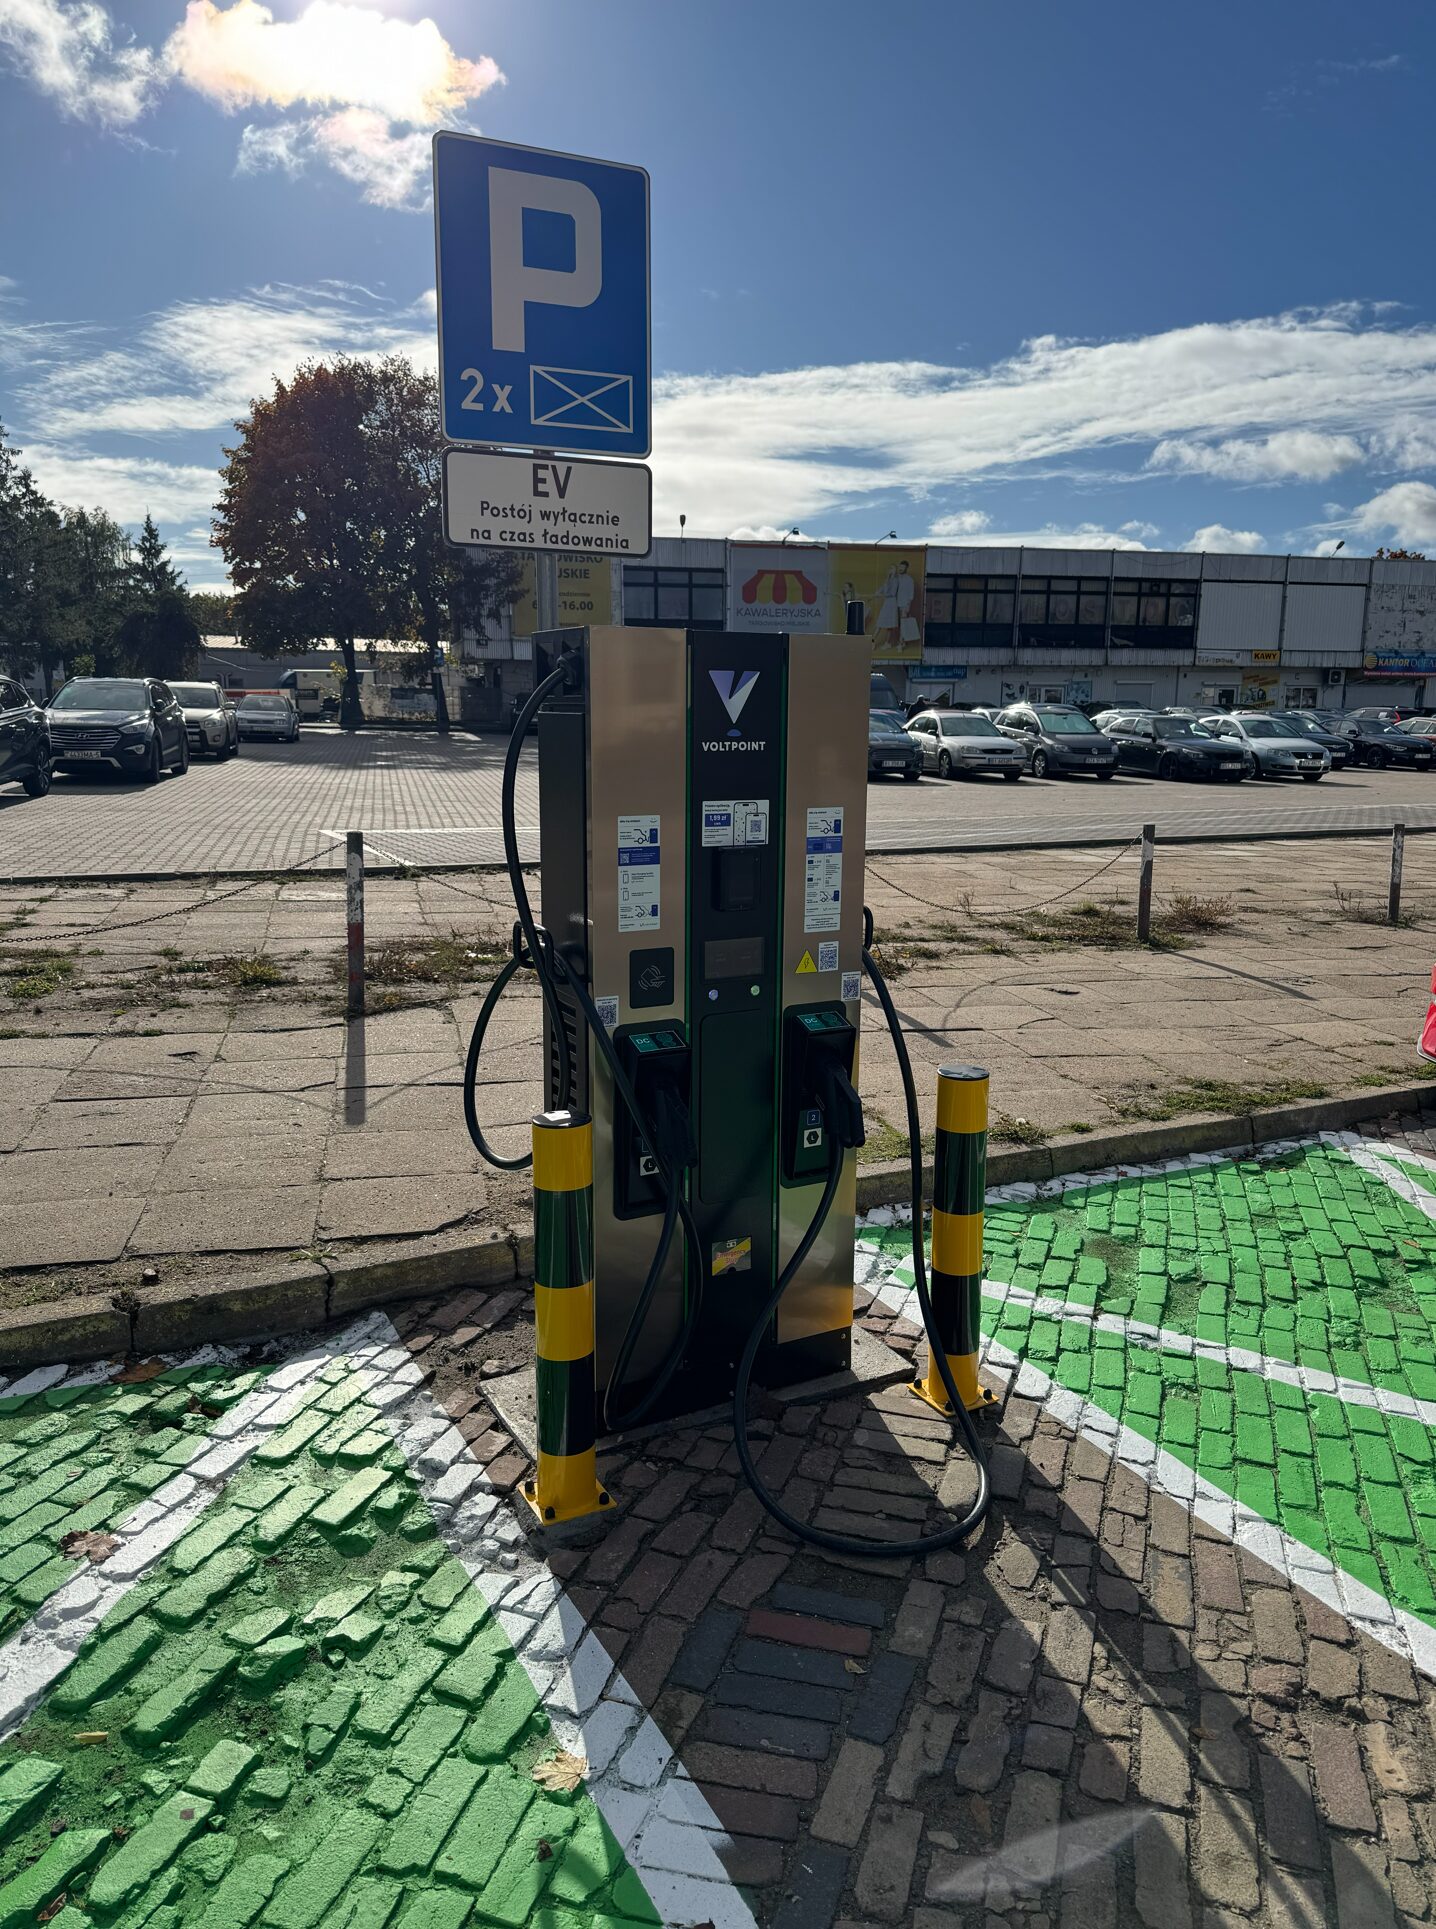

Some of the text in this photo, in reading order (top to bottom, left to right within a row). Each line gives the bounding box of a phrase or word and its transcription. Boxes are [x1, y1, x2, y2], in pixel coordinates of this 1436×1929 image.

[488, 166, 602, 353] P
[532, 463, 573, 499] EV
[480, 501, 620, 528] Postój wyłącznie
[470, 529, 630, 549] na czas ładowania
[736, 607, 822, 618] KAWALERYJSKA
[1254, 652, 1278, 660] KAWY
[1378, 657, 1436, 668] KANTOR OCEA
[702, 741, 766, 752] VOLTPOINT
